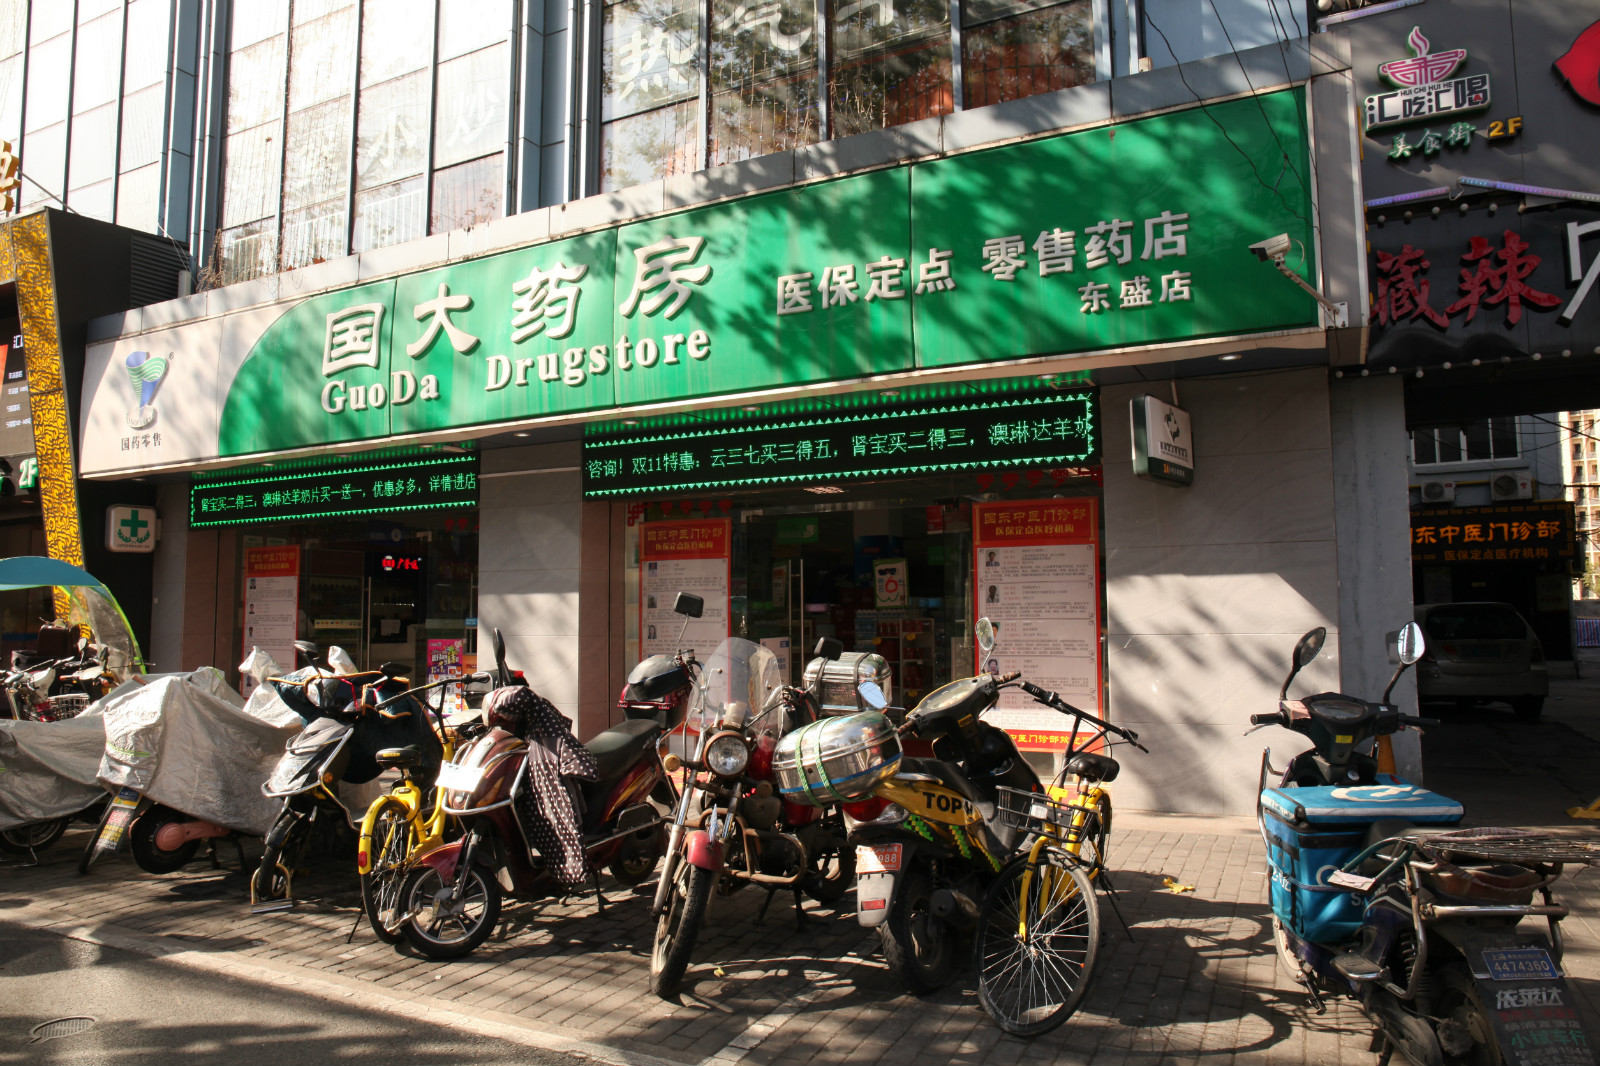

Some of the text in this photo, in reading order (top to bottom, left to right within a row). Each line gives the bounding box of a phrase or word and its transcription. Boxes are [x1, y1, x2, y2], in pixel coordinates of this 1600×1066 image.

[1367, 74, 1489, 124] 汇吃汇喝
[1401, 81, 1453, 97] HUI CHI HUI HE
[1388, 122, 1476, 158] 美食街
[1489, 116, 1523, 138] 2F
[982, 210, 1190, 282] 零售药店
[776, 248, 957, 316] 医保定点
[1077, 270, 1193, 315] 东盛店
[321, 234, 712, 377] 国大药房
[321, 329, 711, 413] GuoDa Drugstore
[121, 432, 162, 452] 国药零售
[19, 458, 39, 488] 2F
[984, 508, 1086, 525] 国东中医门诊部
[1410, 520, 1561, 544] 东中医门诊部
[1445, 547, 1549, 560] 医保定点医疗机构
[1494, 960, 1550, 972] 4474360
